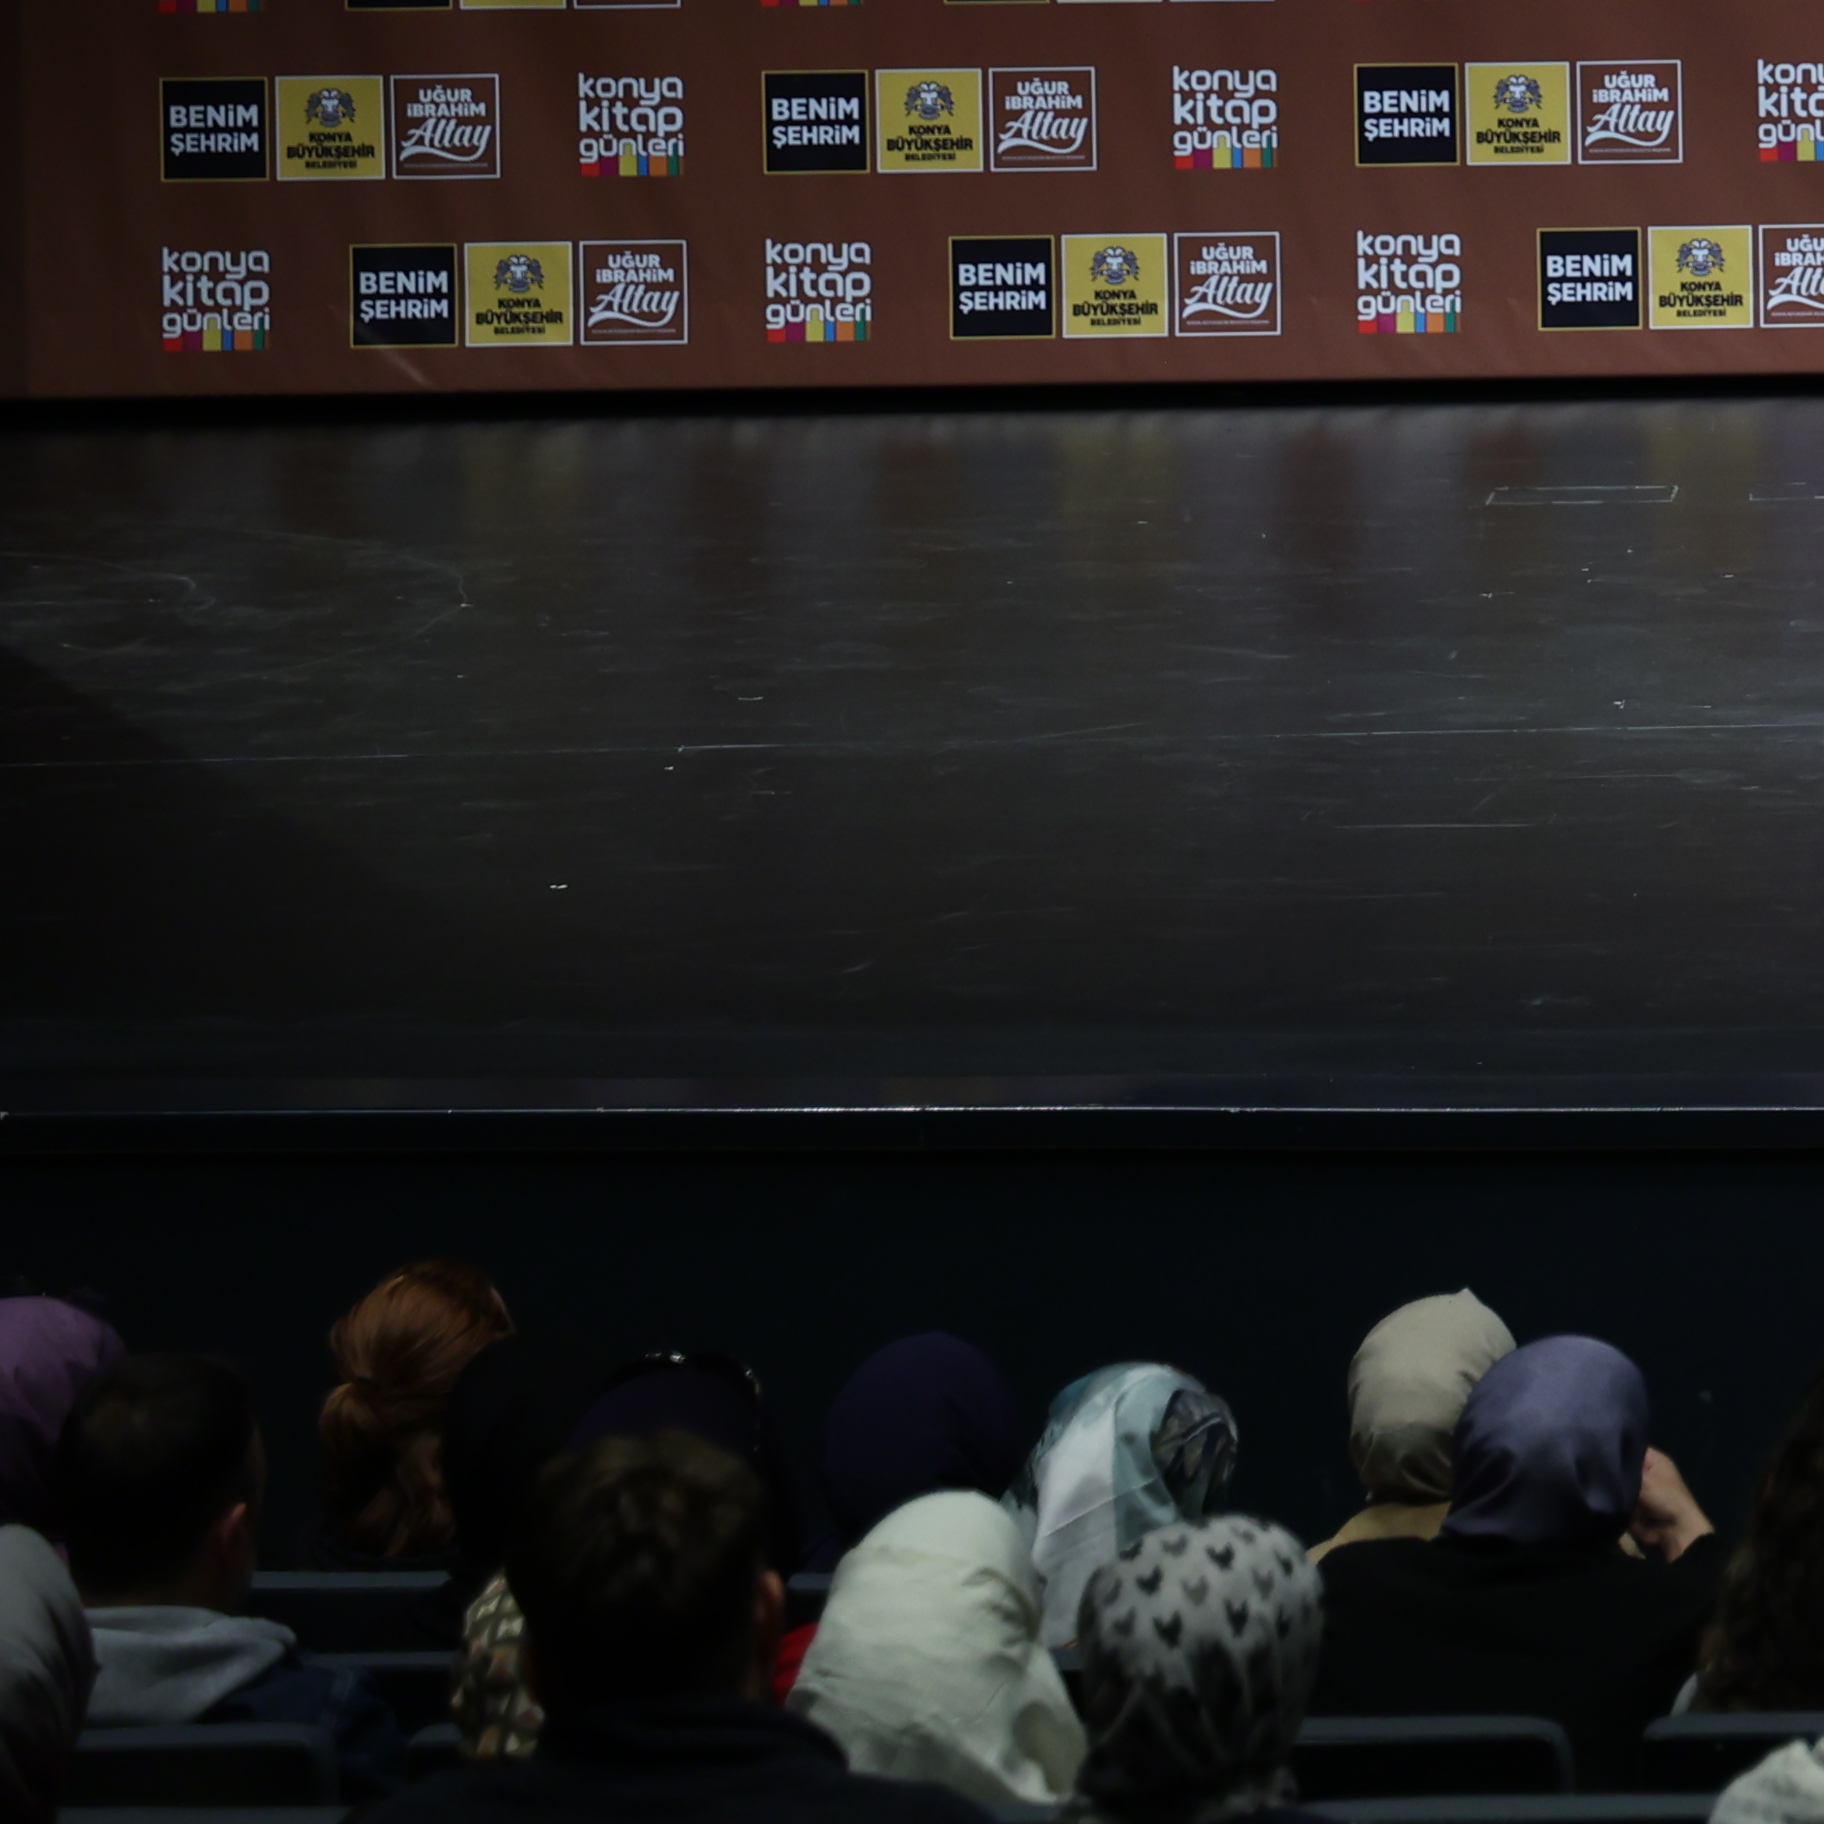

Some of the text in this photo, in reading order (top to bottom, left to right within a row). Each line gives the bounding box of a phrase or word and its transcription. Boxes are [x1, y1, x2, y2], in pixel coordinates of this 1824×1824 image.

[1172, 65, 1278, 98] konya
[1173, 92, 1278, 131] kitap
[1173, 125, 1278, 157] günleri
[765, 238, 871, 271] konya
[1202, 242, 1254, 260] UĞUR
[765, 264, 872, 304] kitap
[1182, 274, 1273, 319] Altay
[765, 298, 872, 330] günleri
